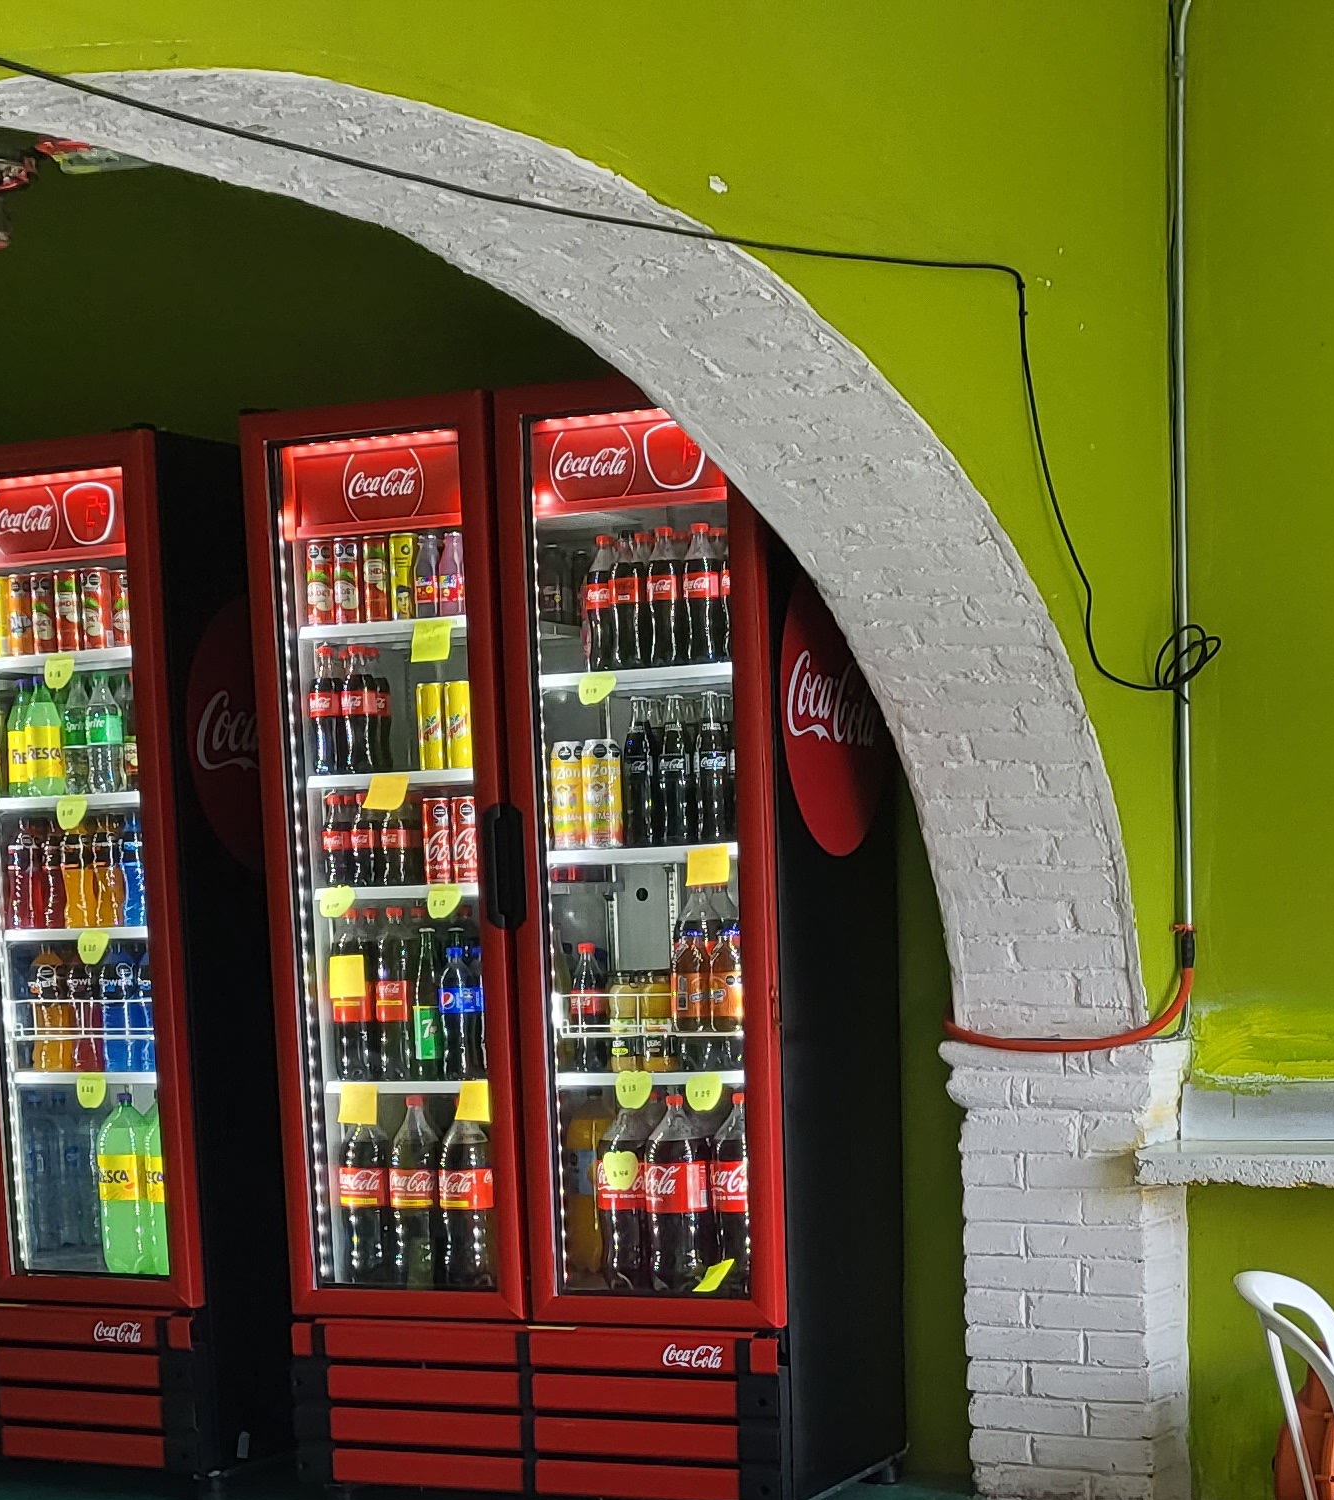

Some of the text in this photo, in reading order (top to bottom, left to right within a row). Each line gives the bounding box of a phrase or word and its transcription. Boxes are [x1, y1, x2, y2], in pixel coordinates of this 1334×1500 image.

[554, 446, 630, 481] Coca-Cola
[348, 467, 418, 500] Coca-Cola
[94, 1321, 142, 1343] Coca-Cola
[662, 1343, 724, 1369] Coca-Cola
